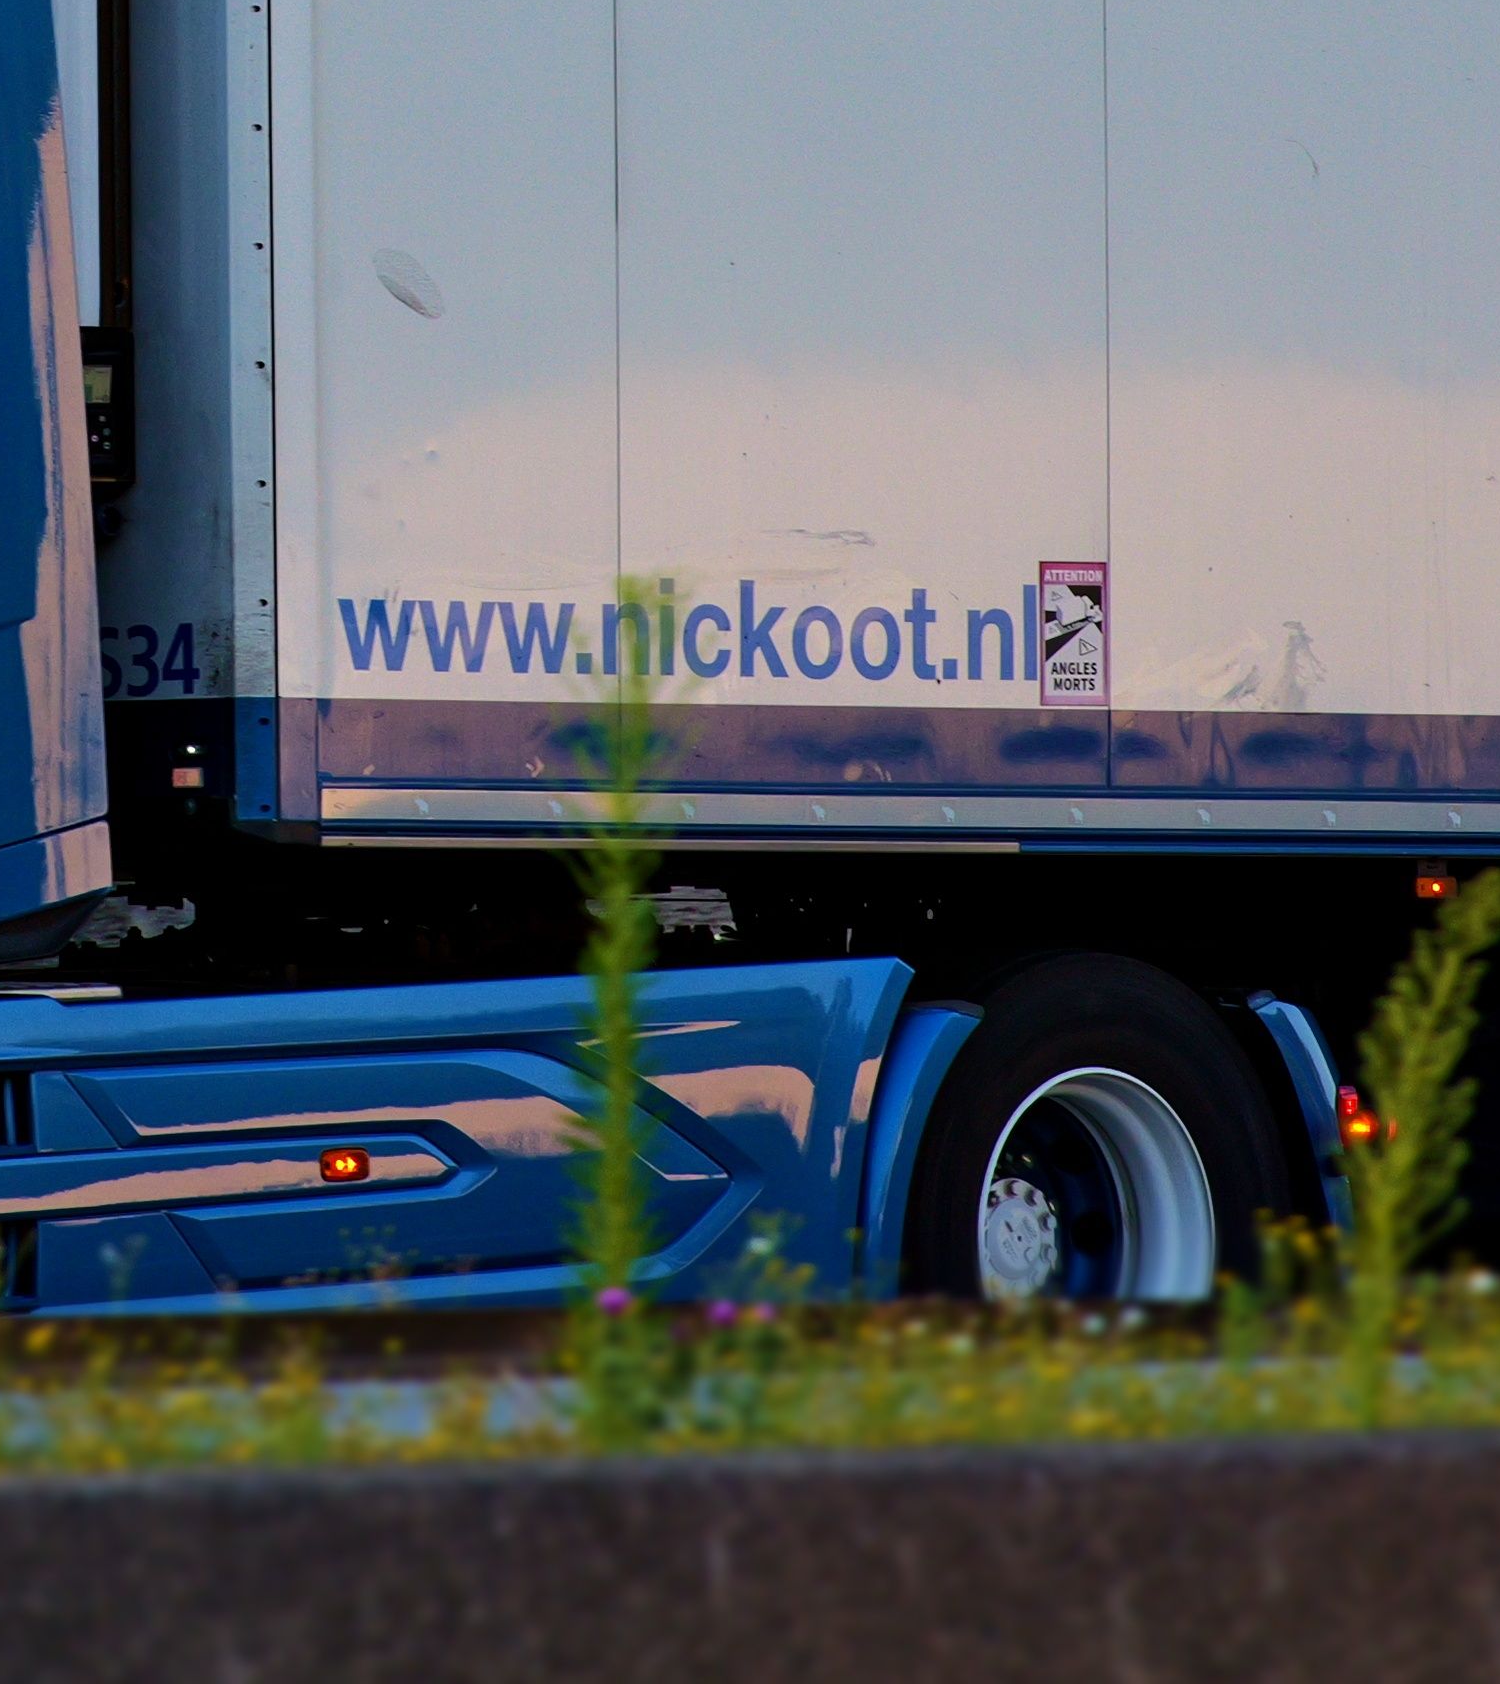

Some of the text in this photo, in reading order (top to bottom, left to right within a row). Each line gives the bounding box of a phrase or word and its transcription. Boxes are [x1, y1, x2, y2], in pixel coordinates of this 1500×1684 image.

[1043, 570, 1103, 583] ATTENTION
[337, 577, 1037, 681] www.nickoot.nl
[1051, 663, 1098, 676] ANGLES
[1054, 678, 1096, 691] MORTS
